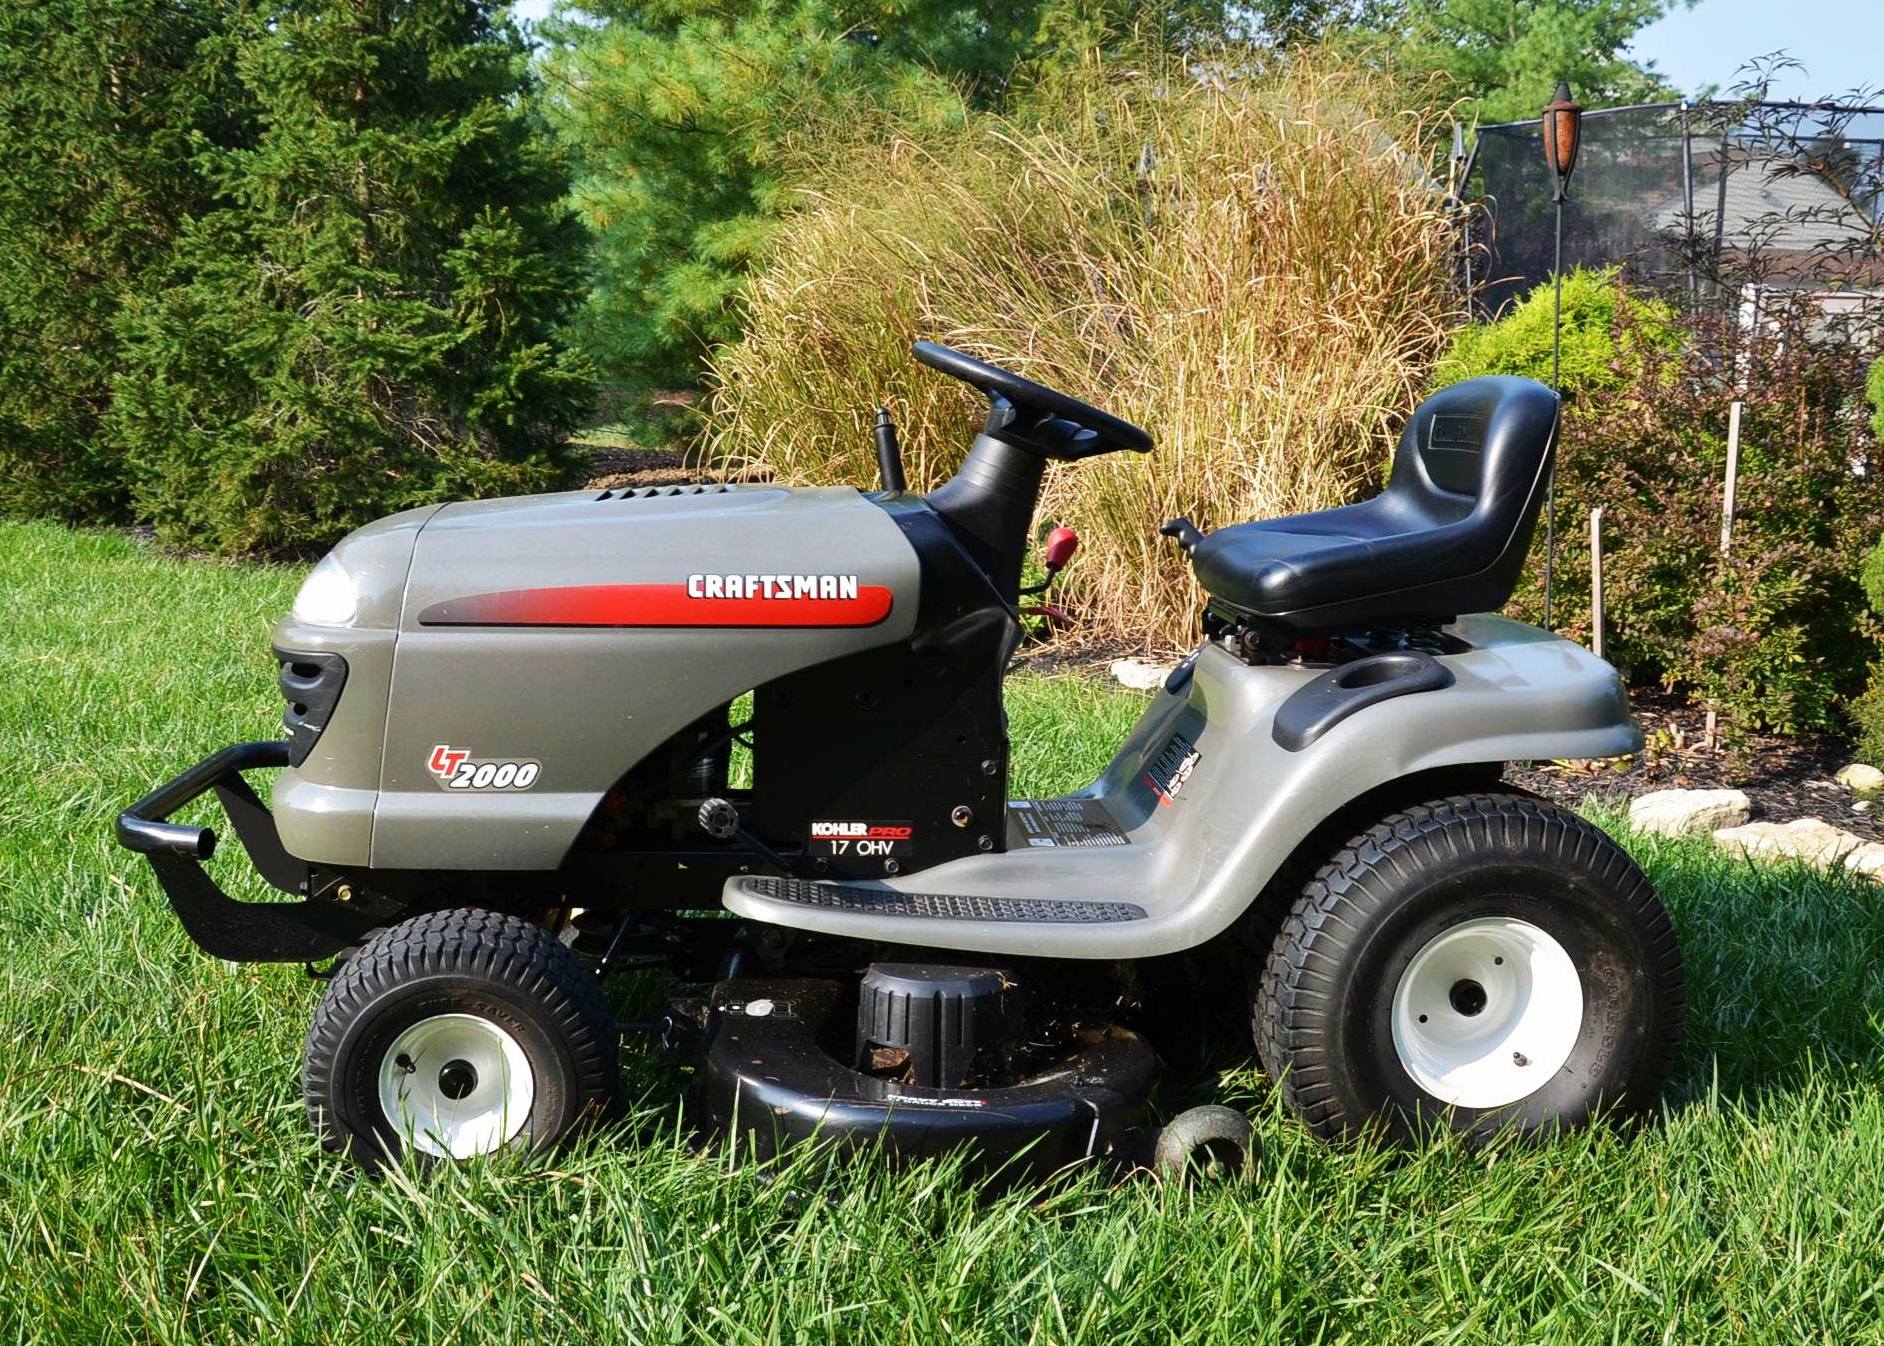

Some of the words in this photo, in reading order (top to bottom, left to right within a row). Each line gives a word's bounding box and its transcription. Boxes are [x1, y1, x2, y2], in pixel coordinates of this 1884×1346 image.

[687, 574, 858, 599] CRAFTSMAN
[428, 745, 471, 778] LT
[449, 763, 540, 788] 2000
[811, 822, 868, 836] KOHLER
[868, 827, 913, 836] PRO
[830, 840, 850, 855] 17
[856, 840, 894, 855] OHV
